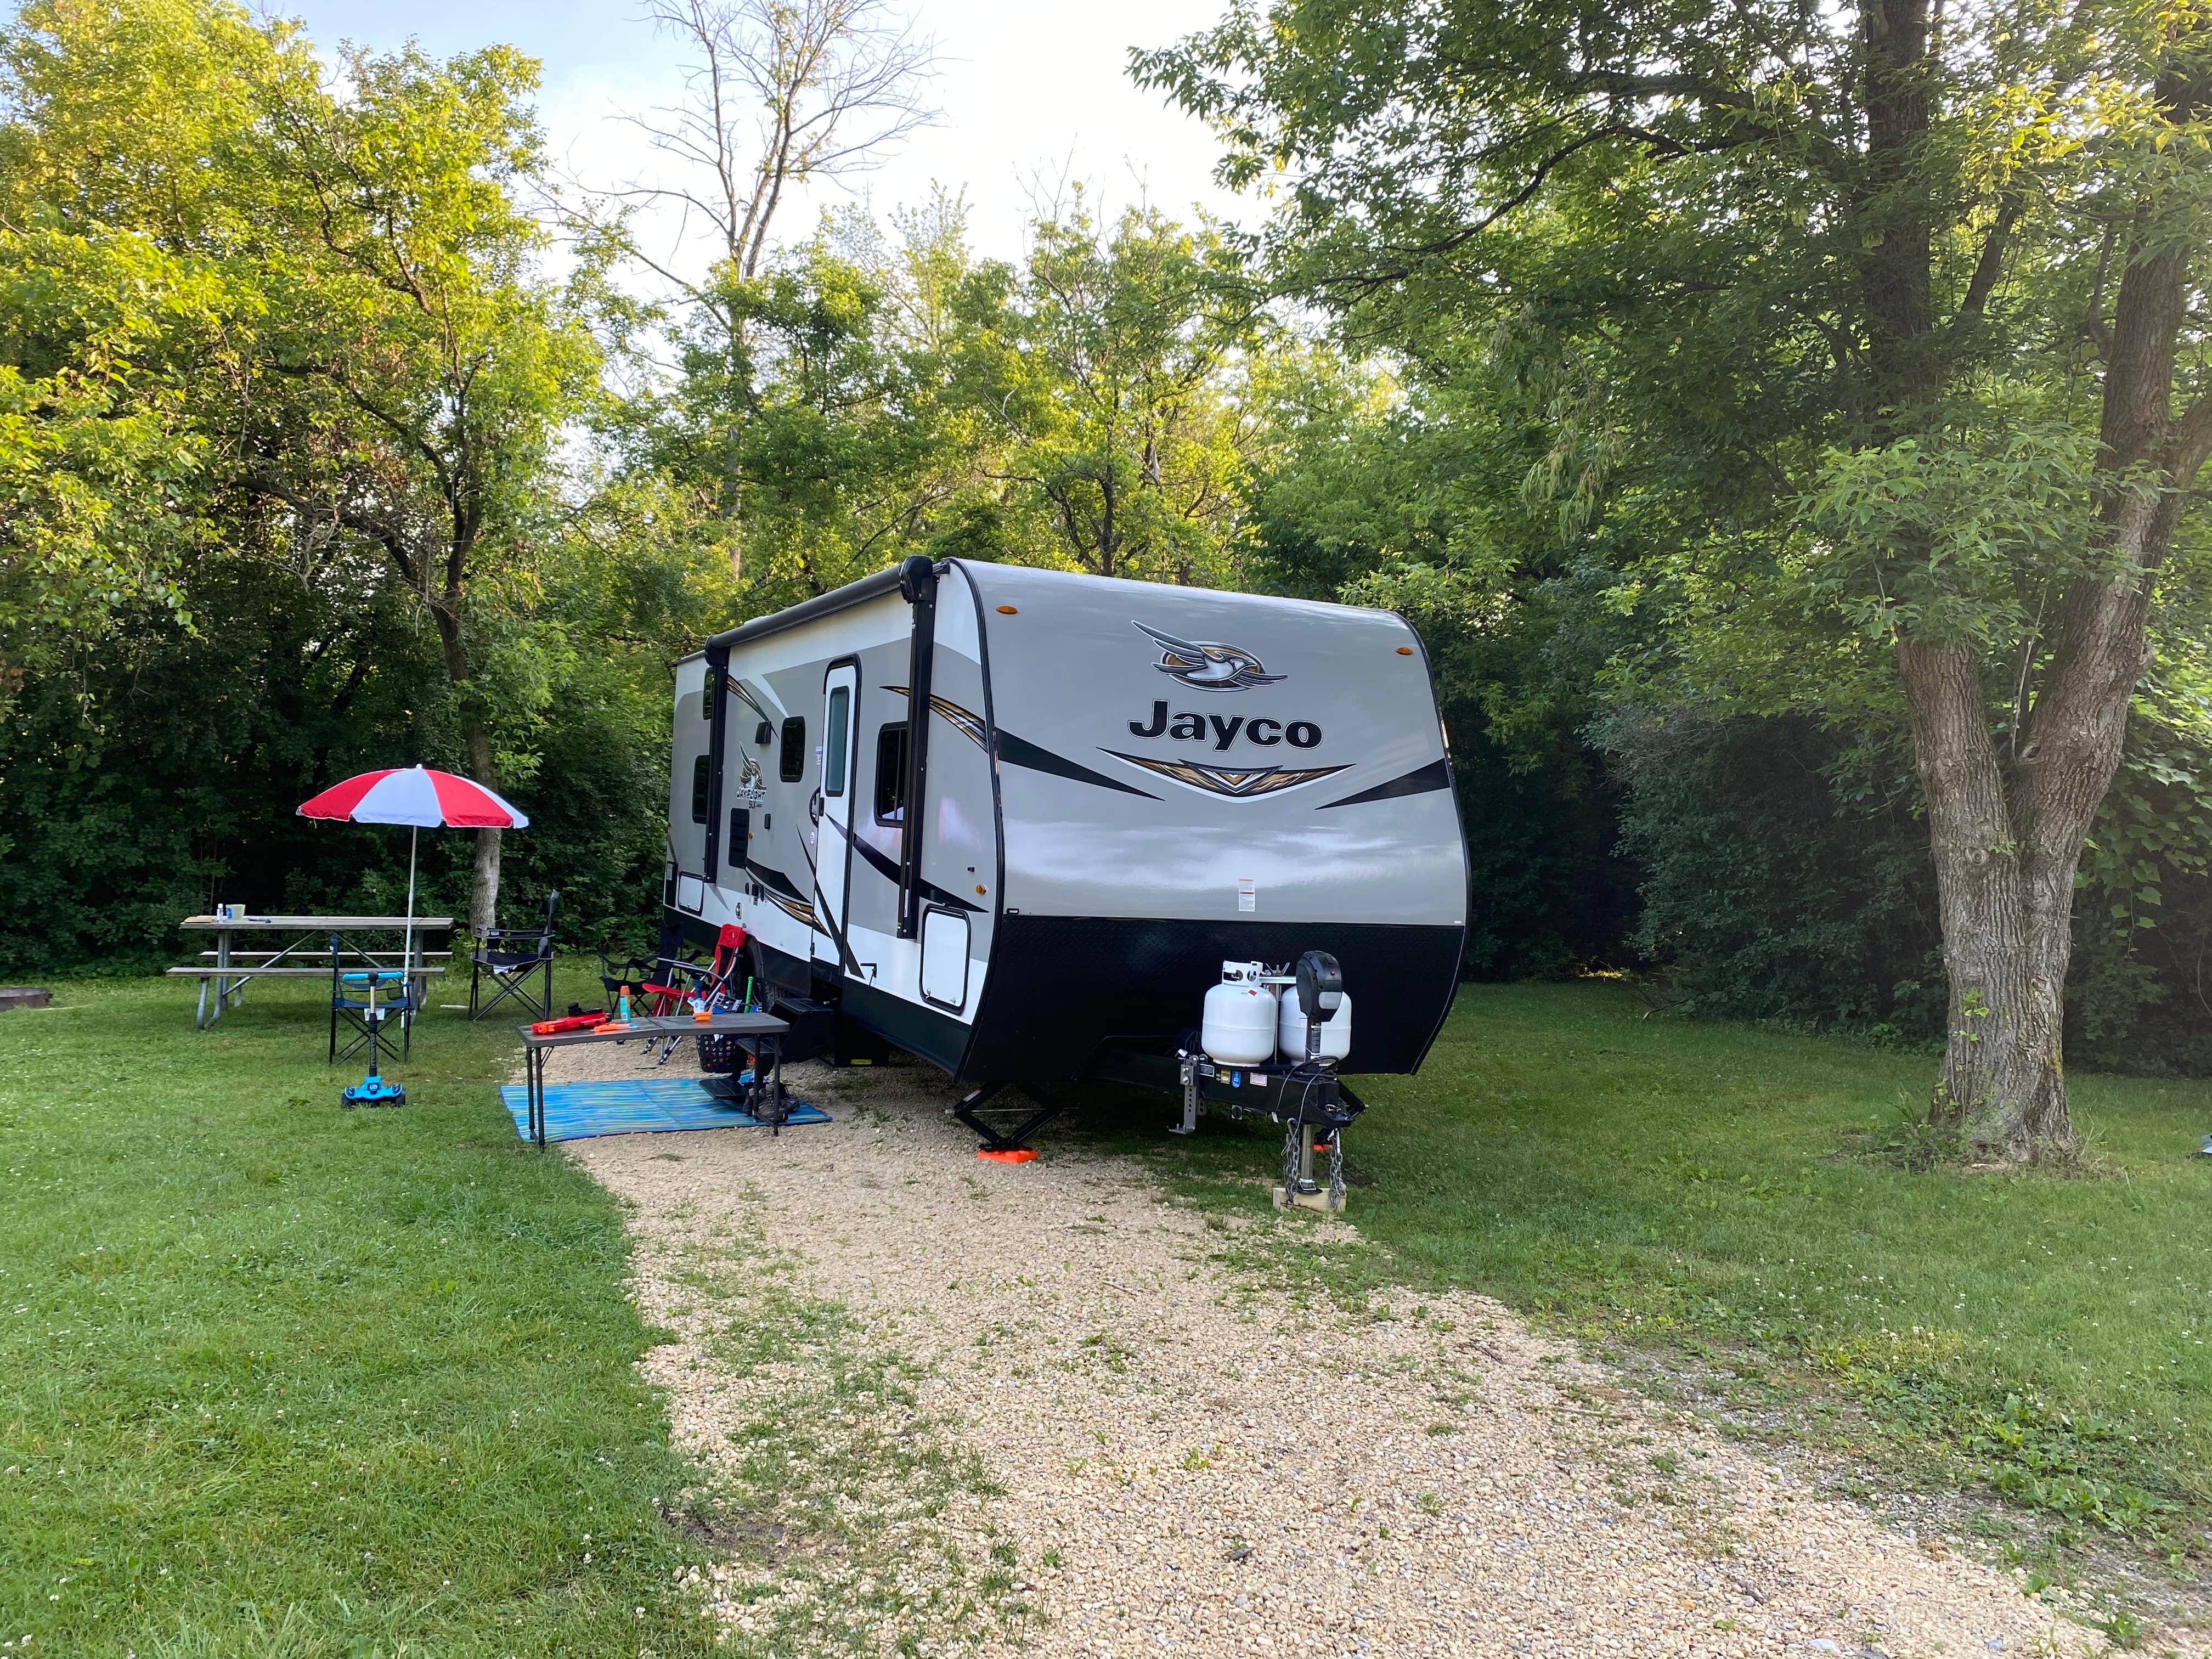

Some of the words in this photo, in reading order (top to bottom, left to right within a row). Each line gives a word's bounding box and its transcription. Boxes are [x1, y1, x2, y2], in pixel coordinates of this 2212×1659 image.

[1128, 699, 1323, 752] Jayco
[737, 787, 747, 799] JAY
[747, 788, 765, 801] FLIGHT
